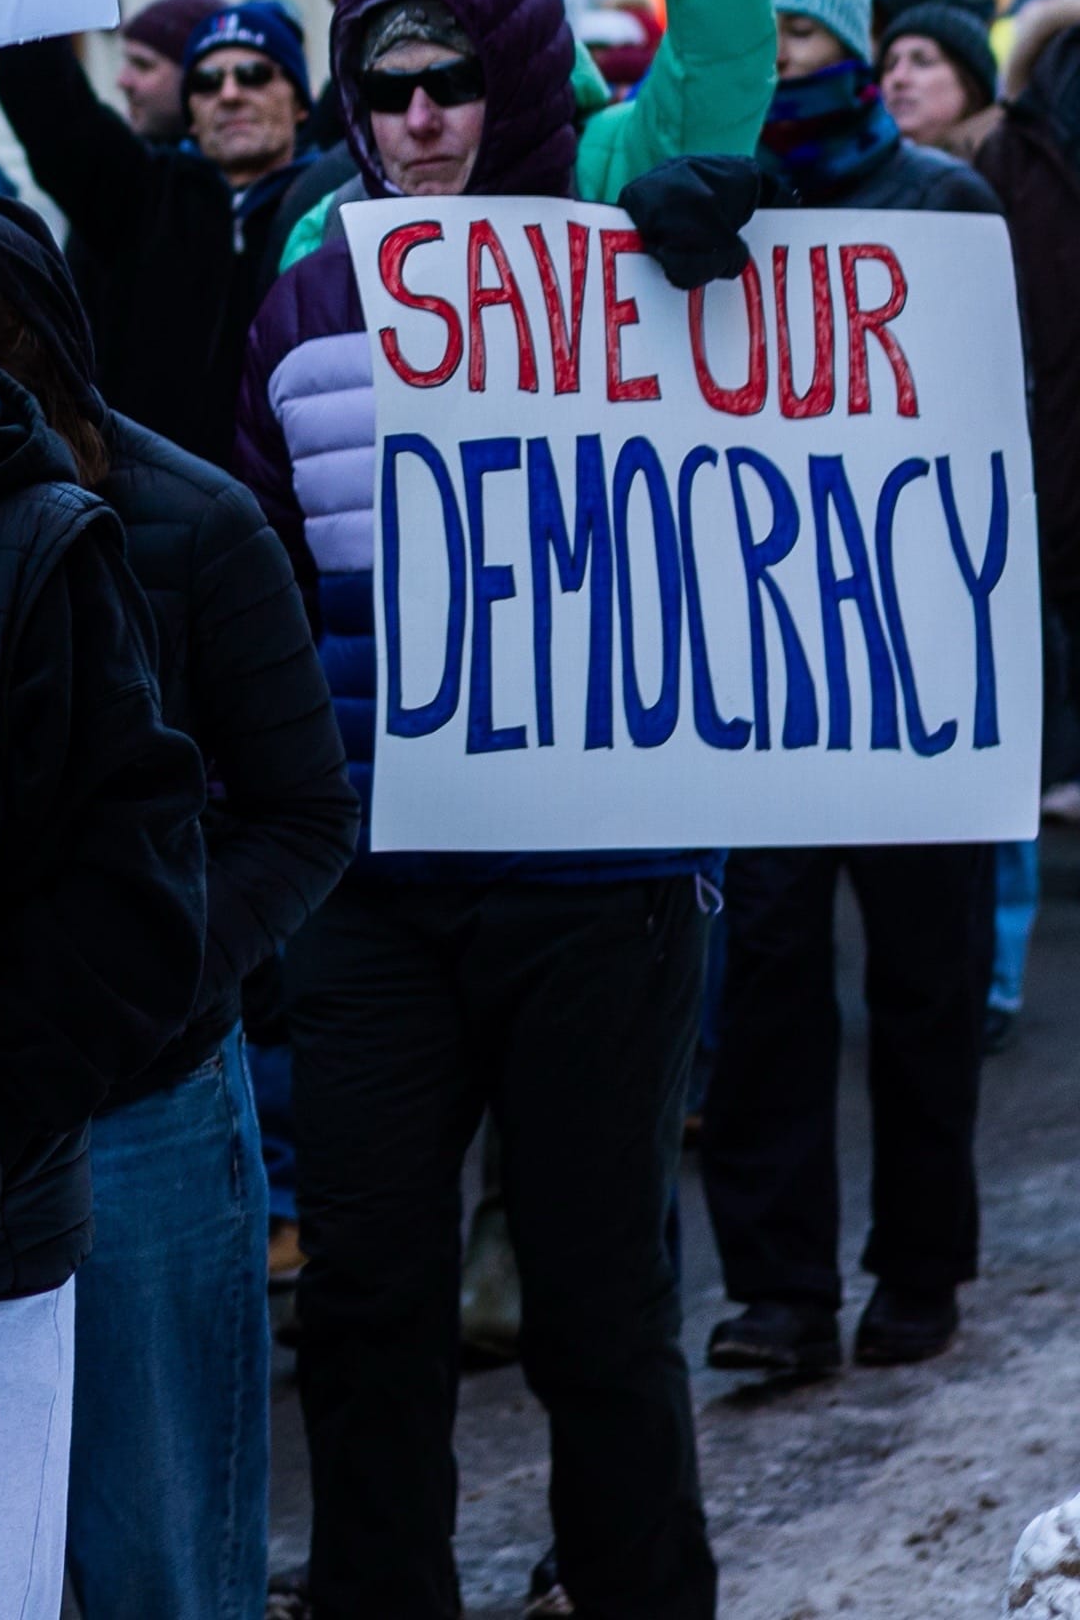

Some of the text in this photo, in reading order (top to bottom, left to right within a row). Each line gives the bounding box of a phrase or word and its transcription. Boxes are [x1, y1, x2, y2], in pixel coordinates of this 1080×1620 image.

[378, 218, 920, 420] SAVE OUR
[379, 432, 1009, 758] DEMOCRACY
